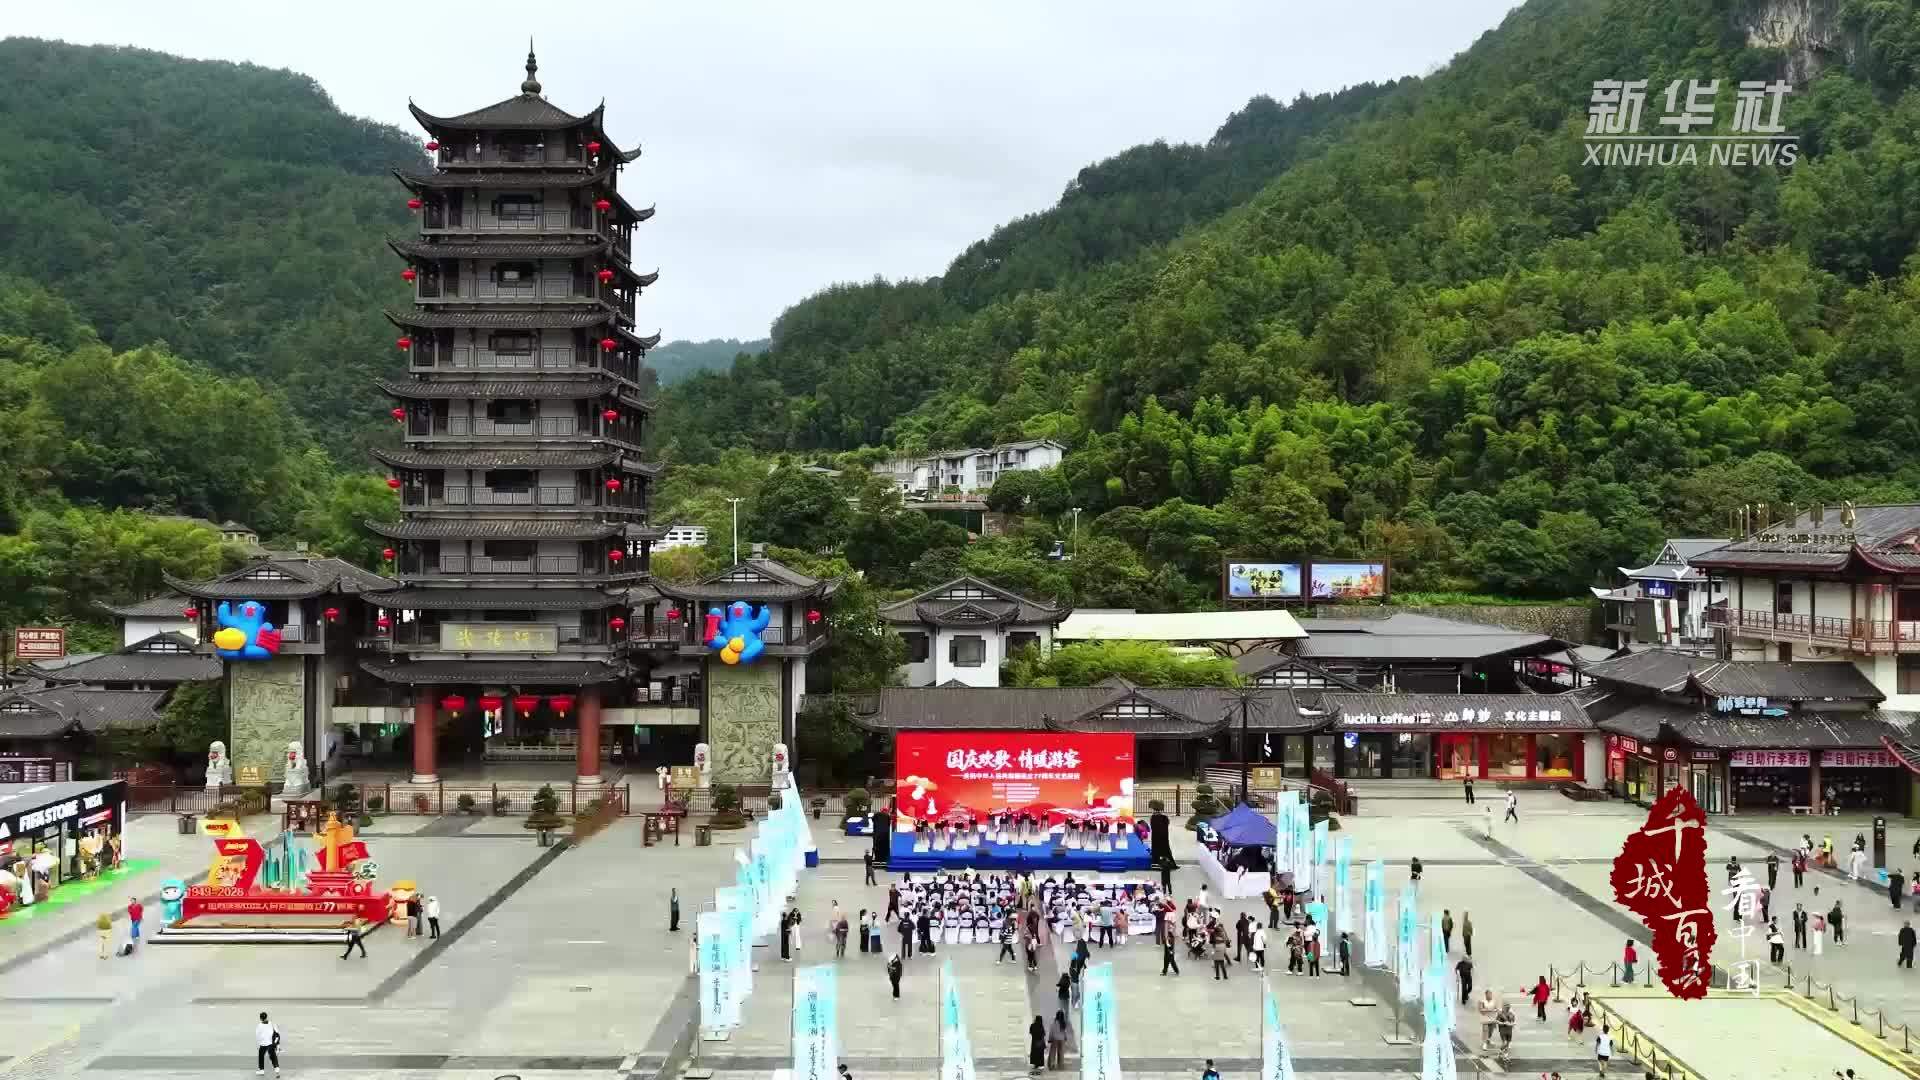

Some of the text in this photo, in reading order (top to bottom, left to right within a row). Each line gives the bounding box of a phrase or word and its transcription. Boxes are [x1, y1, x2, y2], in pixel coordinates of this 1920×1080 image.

[1343, 712, 1378, 724] luckin
[1379, 712, 1416, 724] coffee
[1745, 752, 1809, 766] 自助行李寄存
[45, 799, 79, 824] STORE
